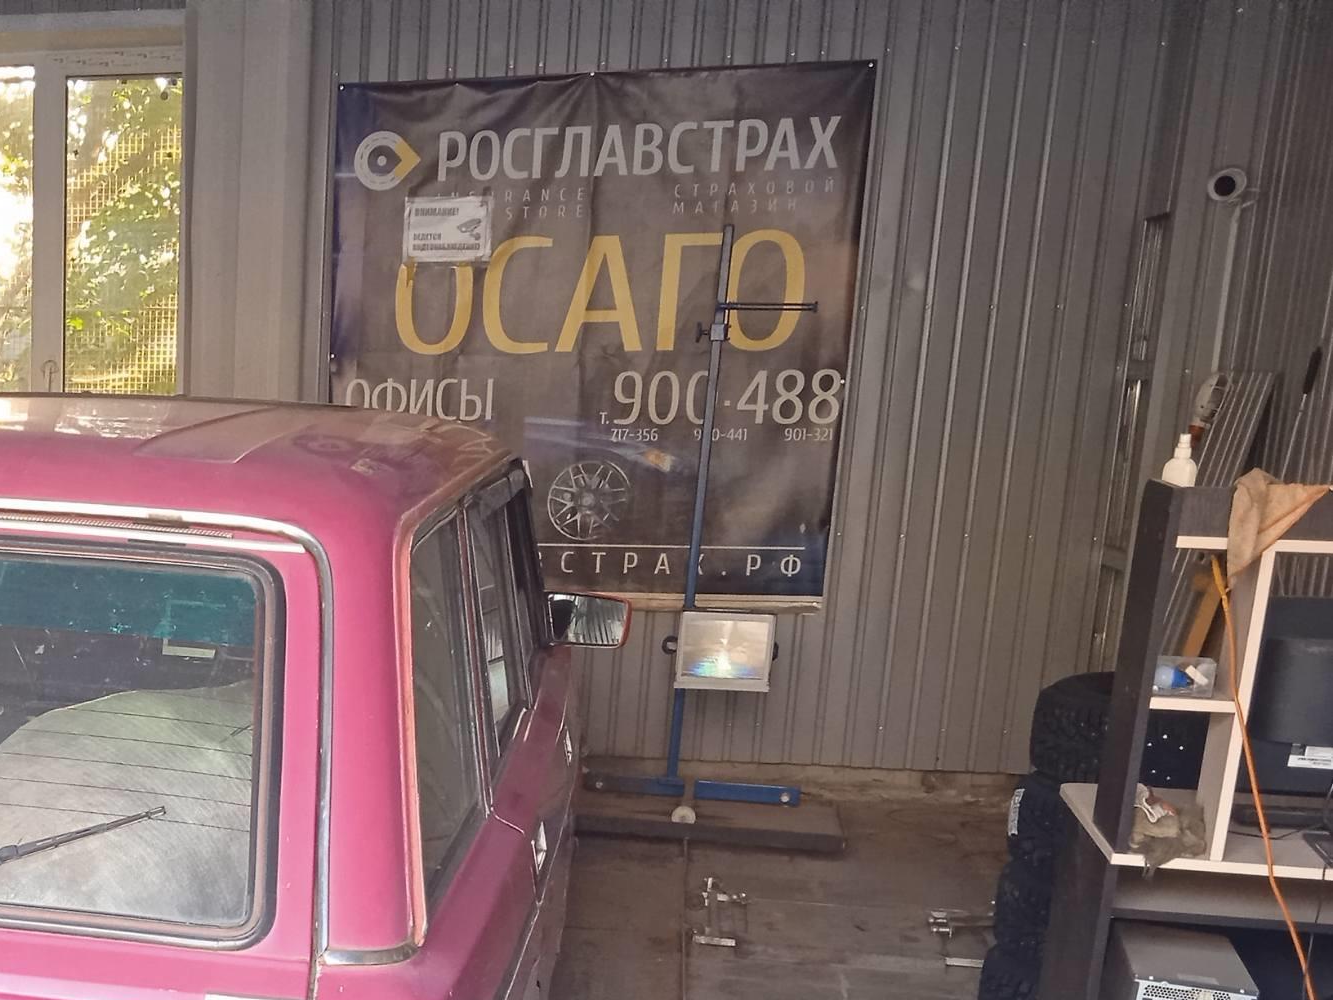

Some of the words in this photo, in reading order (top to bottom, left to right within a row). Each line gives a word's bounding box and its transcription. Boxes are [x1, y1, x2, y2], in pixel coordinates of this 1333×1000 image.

[438, 115, 842, 182] РОСГЛАВСТРАХ
[674, 176, 835, 198] СТРАХОВОЙ
[505, 204, 584, 221] STORE
[673, 198, 797, 215] МАГАЗИН
[395, 229, 807, 354] ОСАГО
[345, 377, 495, 422] ОФИСЫ
[693, 428, 748, 442] 90-441
[784, 427, 834, 442] 901-321
